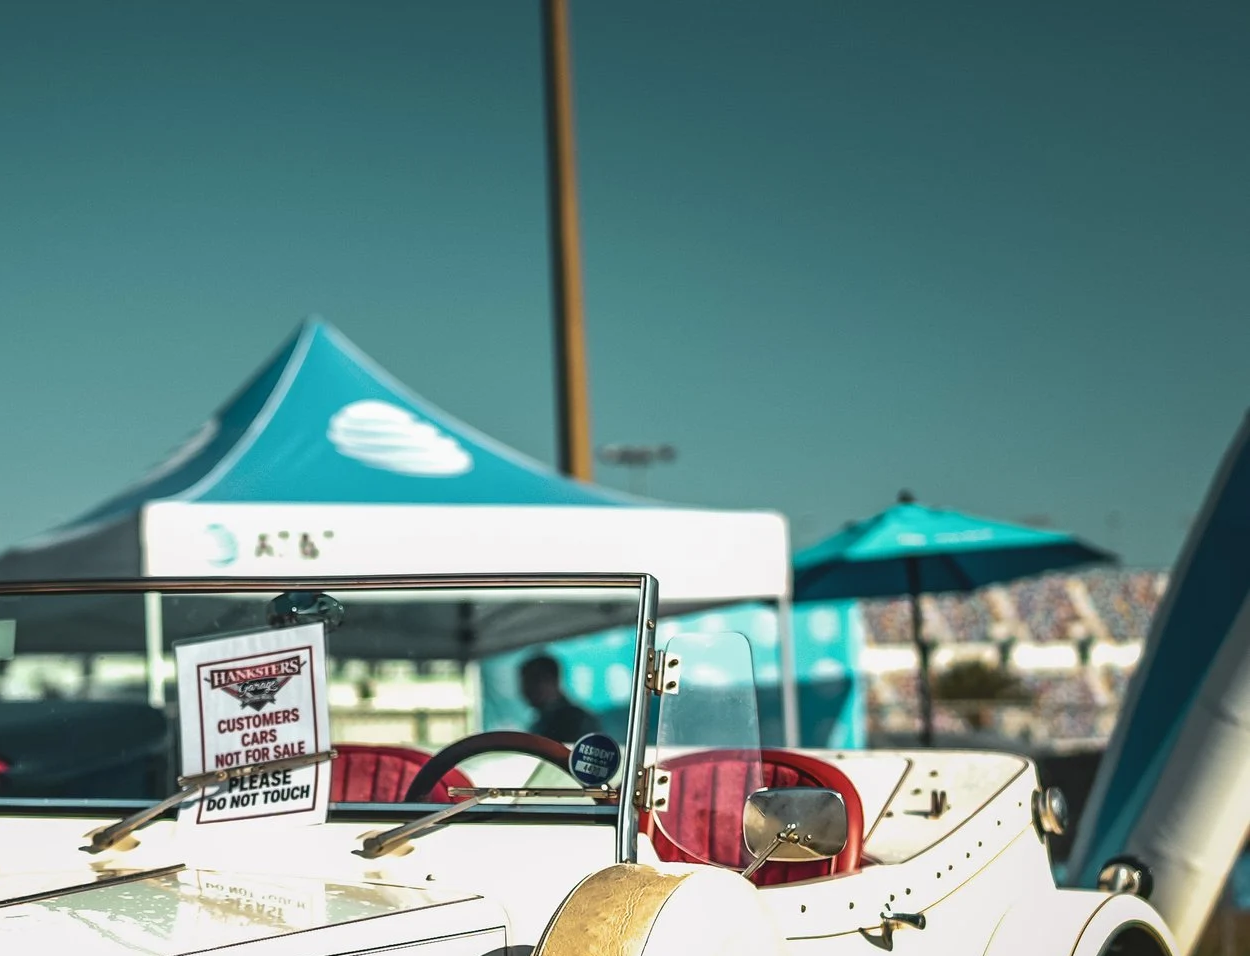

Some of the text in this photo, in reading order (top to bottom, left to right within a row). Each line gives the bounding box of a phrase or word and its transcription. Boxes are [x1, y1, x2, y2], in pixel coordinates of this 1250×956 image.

[212, 658, 299, 687] HANKSTERS
[237, 680, 278, 697] Garage
[217, 708, 300, 734] CUSTOMERS
[241, 729, 277, 747] CARS
[215, 741, 305, 768] NOT FOR SALE
[578, 743, 615, 762] RESIDENT
[228, 768, 292, 793] PLEASE
[206, 784, 311, 811] DO NOT TOUCH
